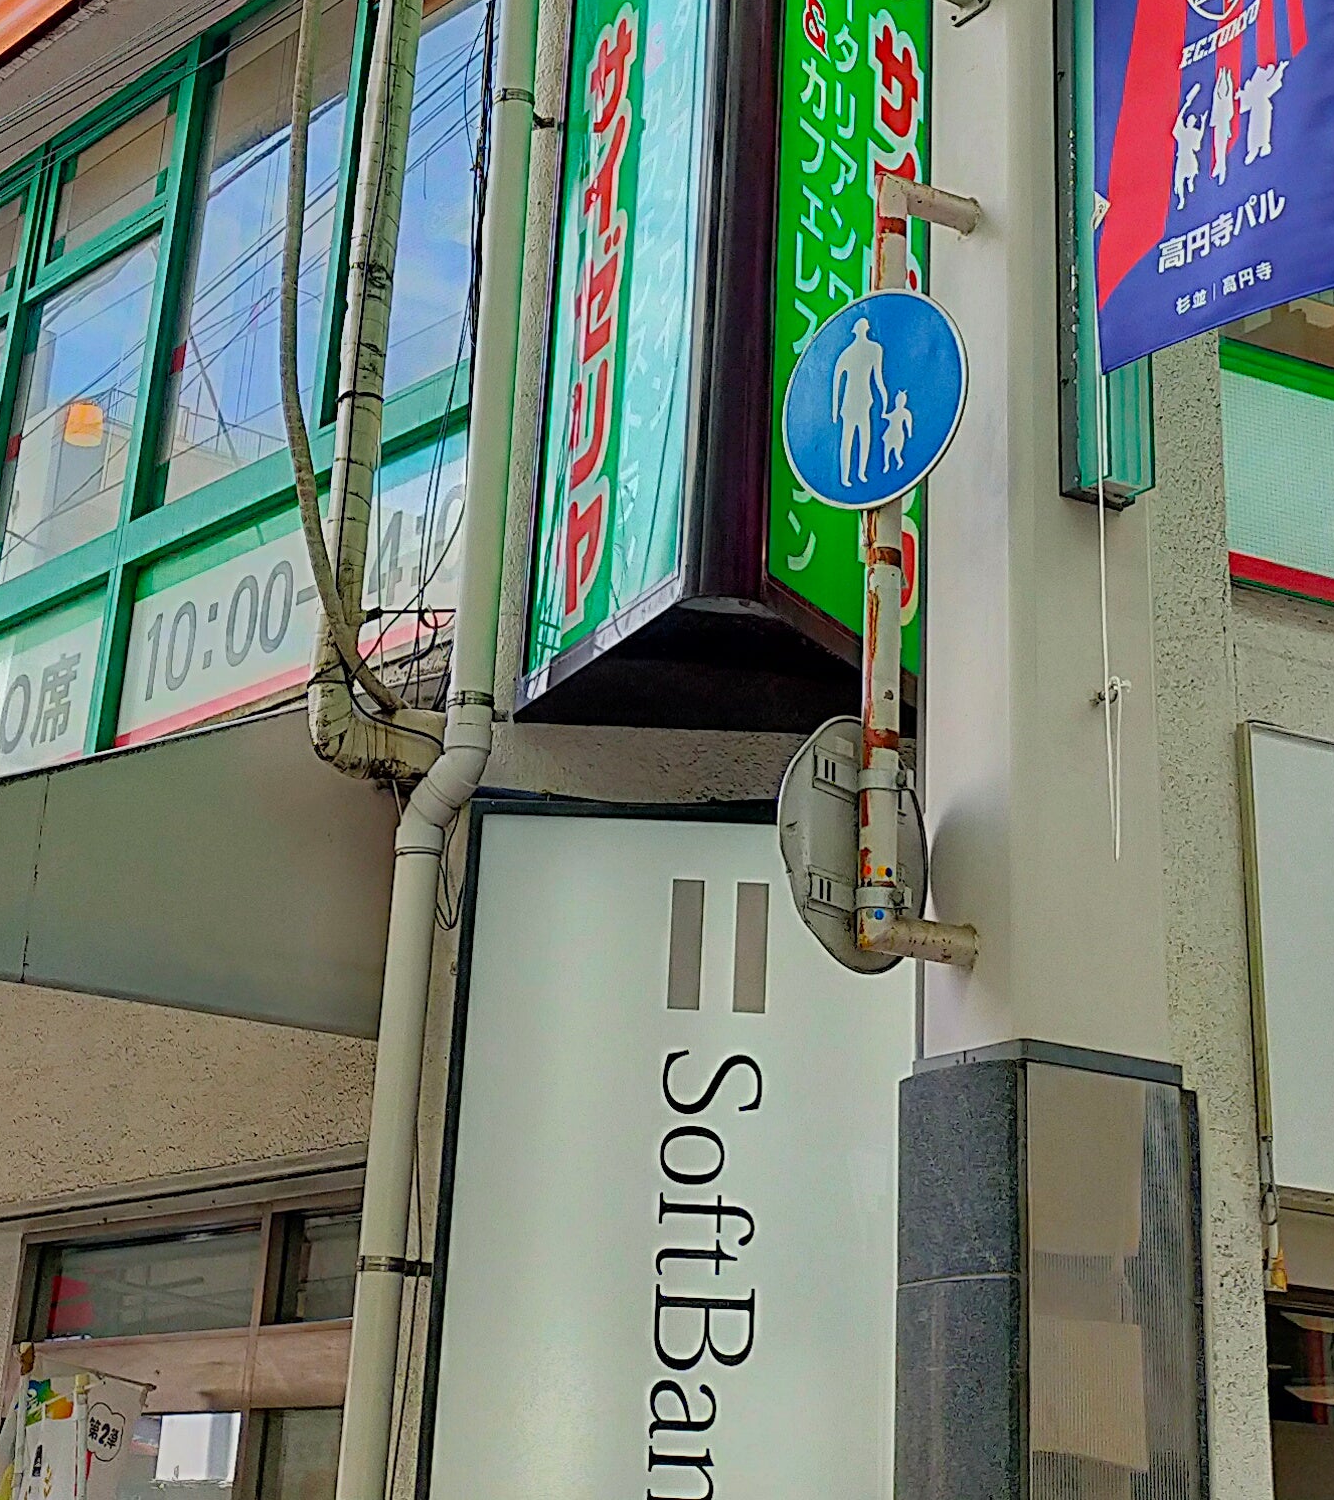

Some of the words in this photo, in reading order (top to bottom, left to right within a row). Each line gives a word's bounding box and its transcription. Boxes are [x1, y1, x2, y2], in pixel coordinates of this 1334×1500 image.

[1158, 188, 1286, 274] 高円寺パル
[563, 15, 633, 617] サイゼリヤ
[1222, 261, 1272, 296] 高円寺
